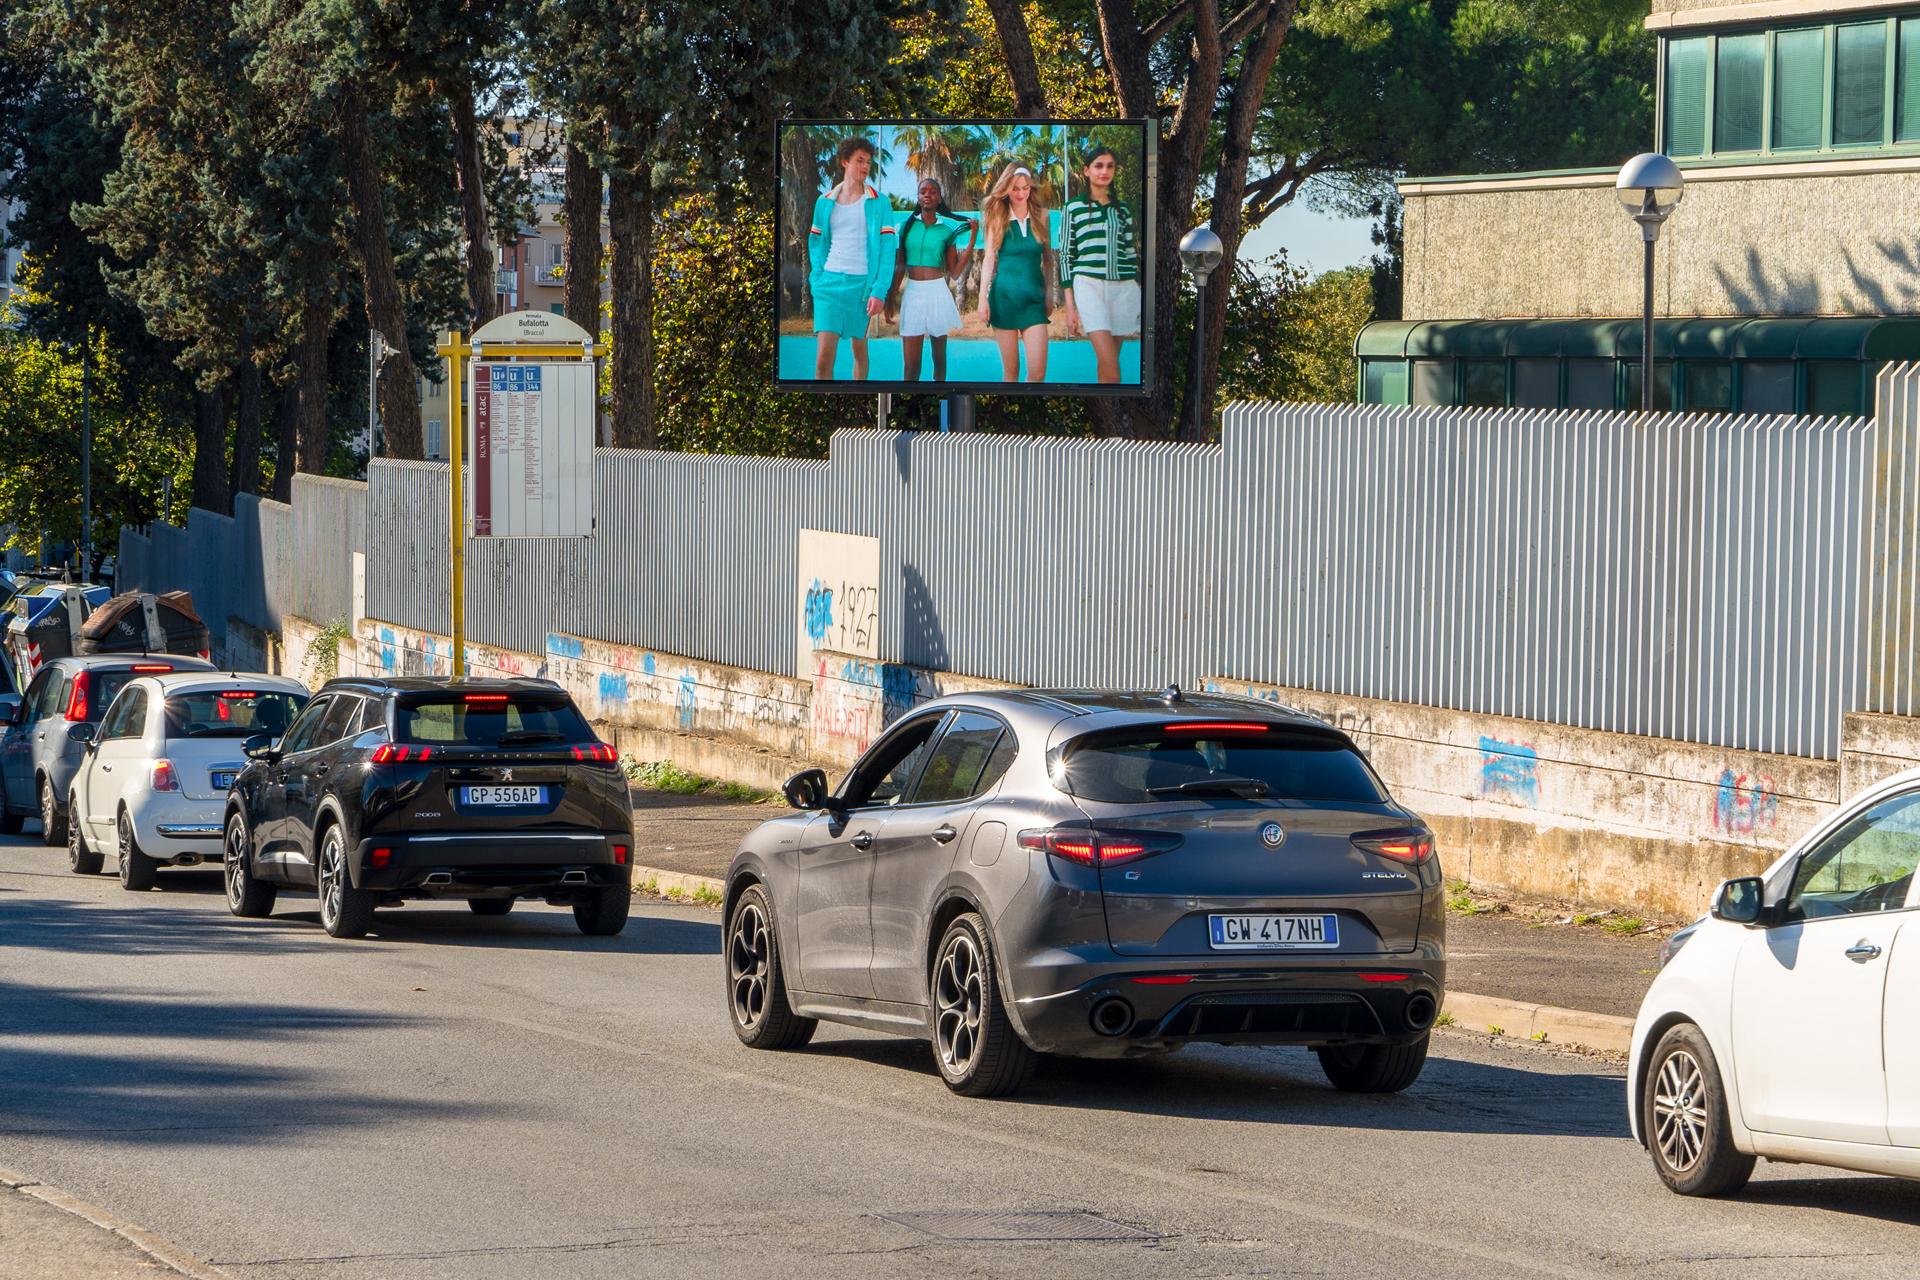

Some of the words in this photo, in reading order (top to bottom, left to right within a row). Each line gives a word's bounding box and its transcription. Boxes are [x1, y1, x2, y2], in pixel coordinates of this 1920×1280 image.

[518, 319, 549, 327] Bufalotta
[509, 383, 519, 391] 86
[526, 383, 540, 391] 344
[479, 396, 487, 417] atac
[479, 435, 487, 458] ROMA
[839, 580, 878, 652] 1927
[1361, 871, 1407, 879] STELVIO
